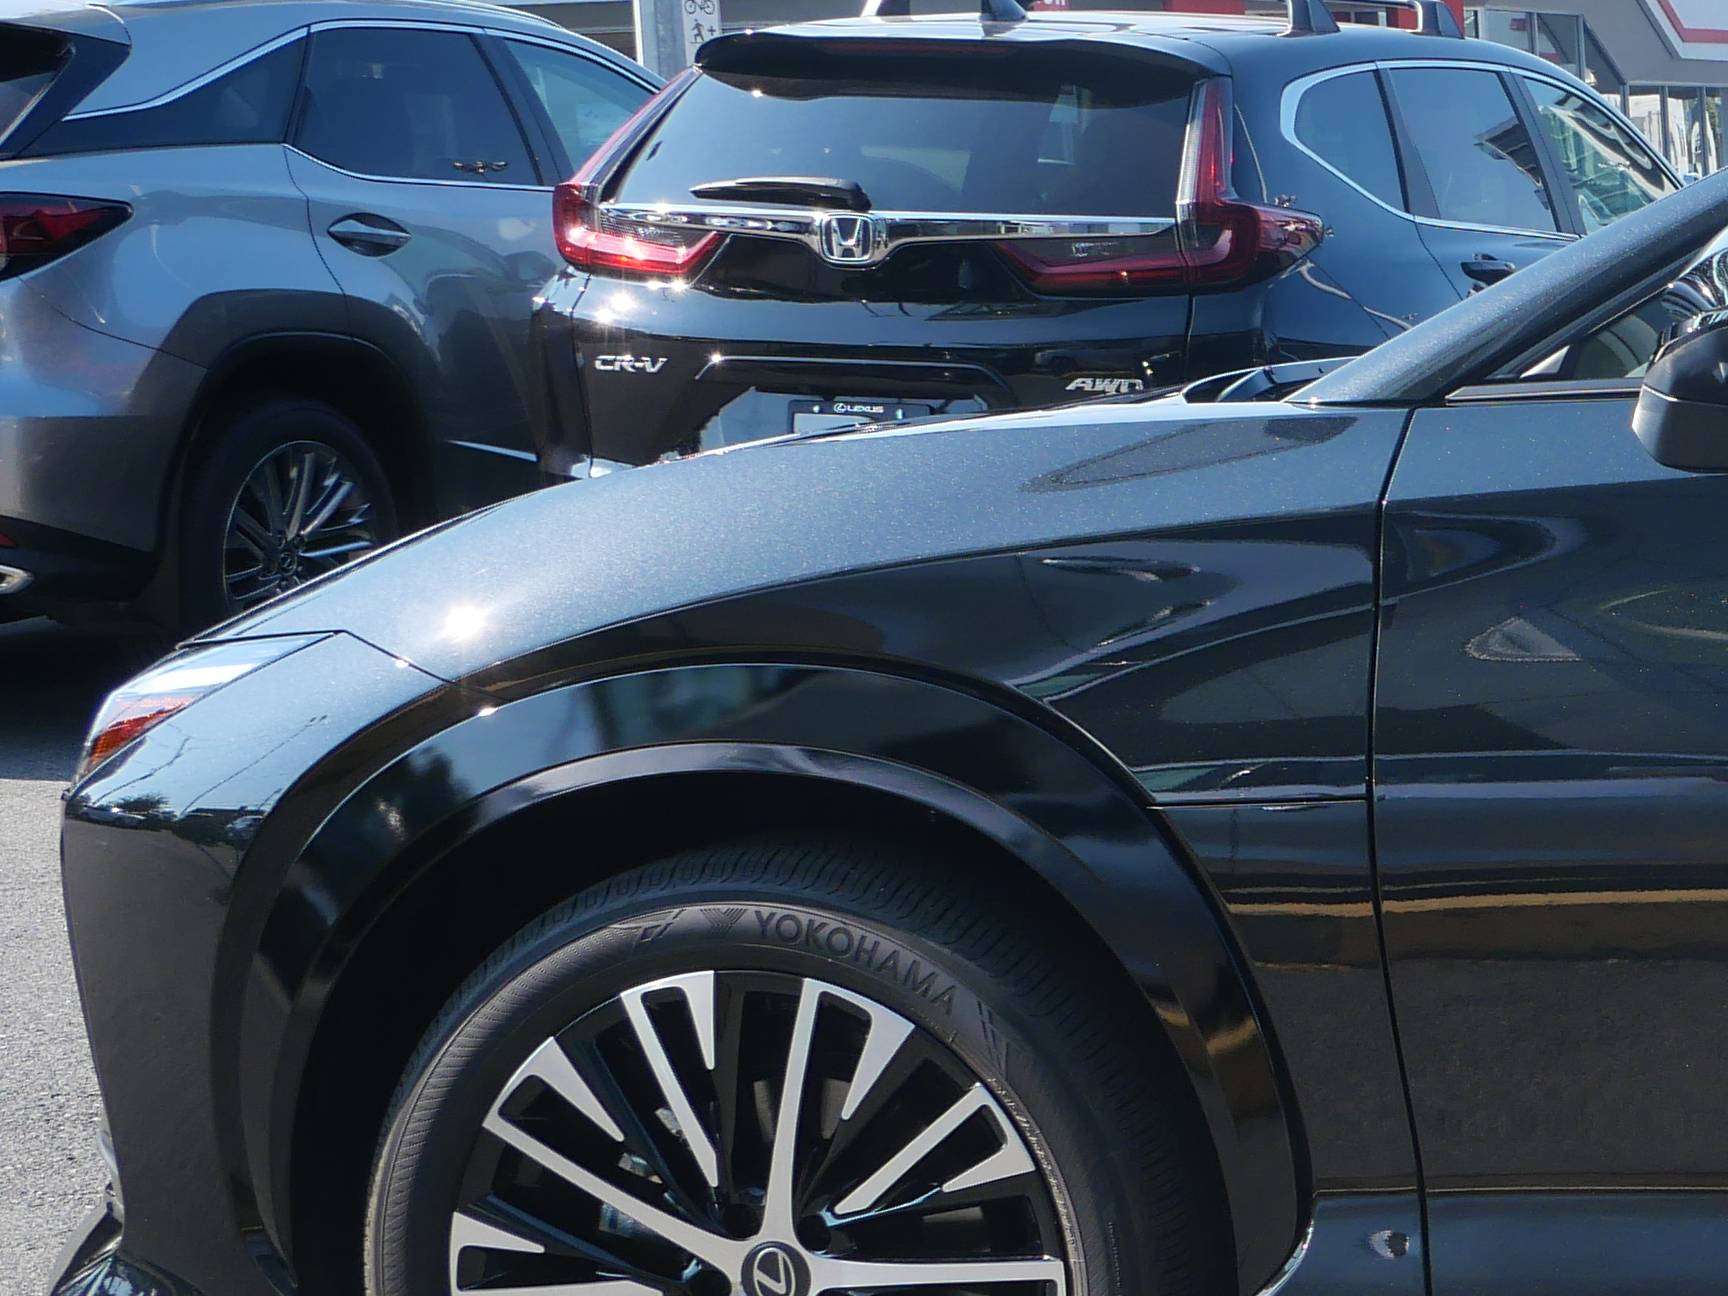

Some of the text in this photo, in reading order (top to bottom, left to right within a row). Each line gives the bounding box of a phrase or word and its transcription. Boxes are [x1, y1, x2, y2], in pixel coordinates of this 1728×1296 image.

[594, 355, 669, 373] CR-V
[1064, 377, 1145, 395] AWD
[753, 909, 957, 1016] YOKOHAMA
